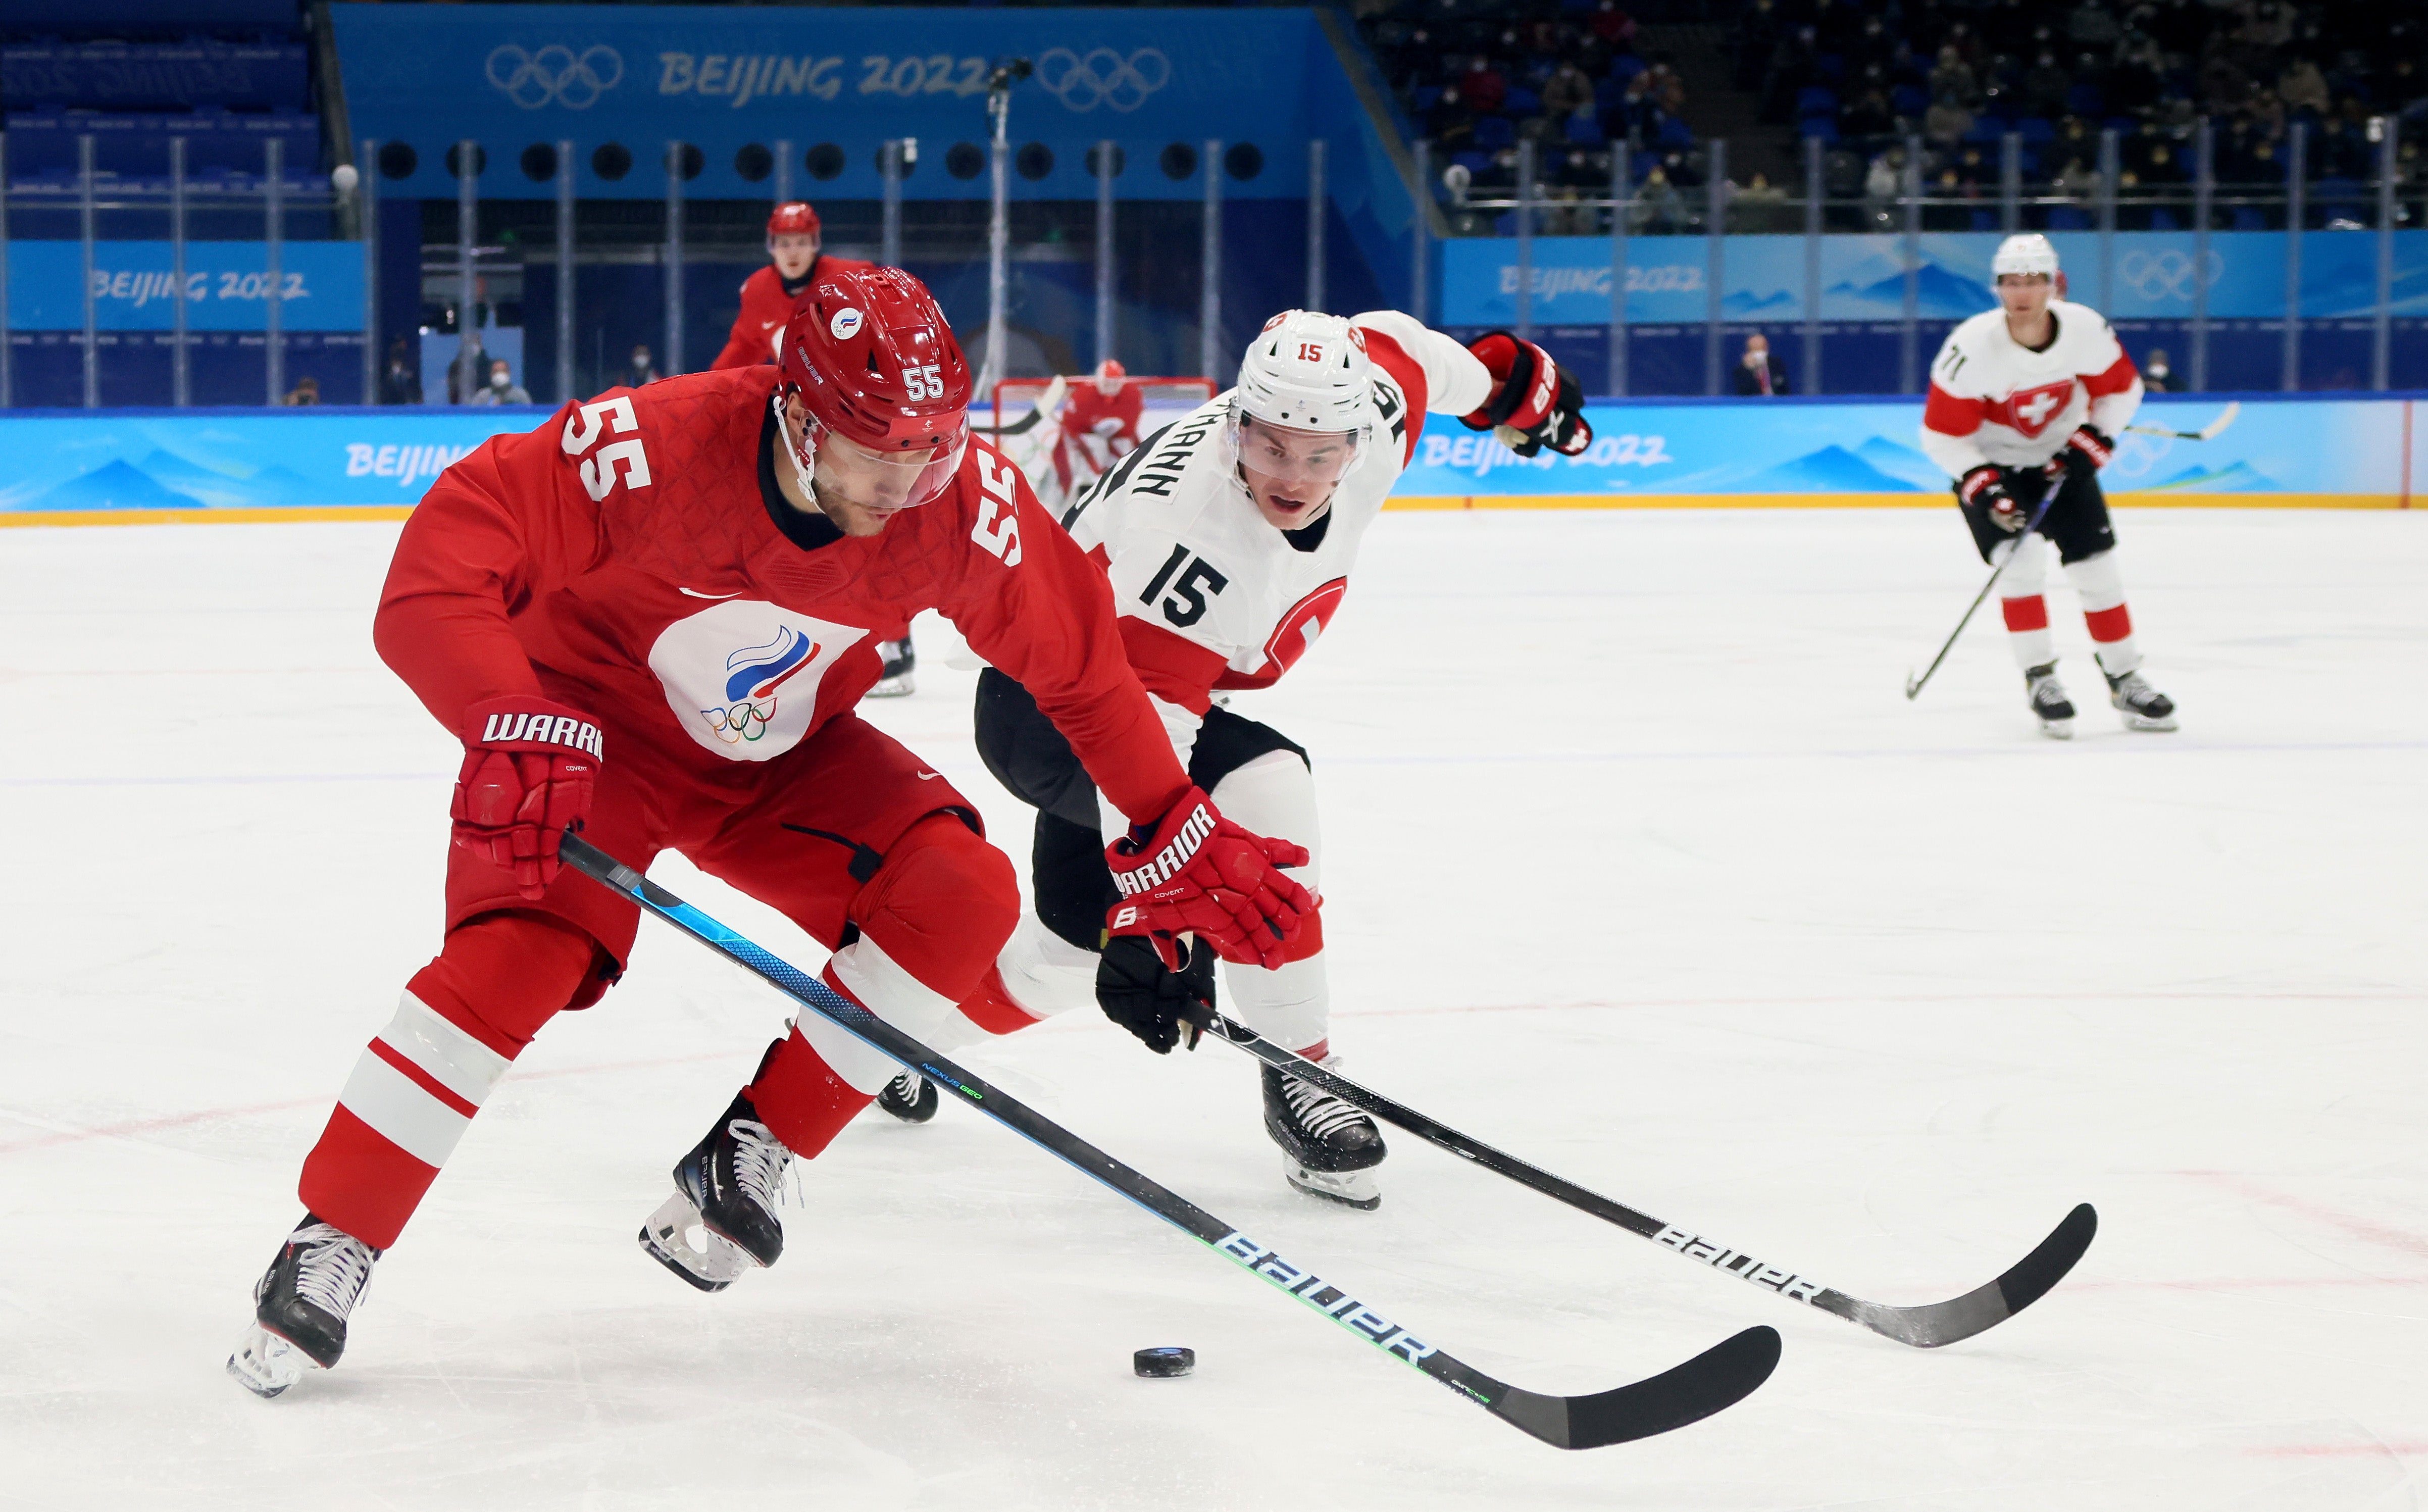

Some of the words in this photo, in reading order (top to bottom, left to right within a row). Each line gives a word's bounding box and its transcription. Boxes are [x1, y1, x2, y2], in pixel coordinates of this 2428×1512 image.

[659, 53, 844, 108] BEIJING
[860, 56, 991, 97] 2022
[91, 270, 208, 308] BEIJING
[1500, 266, 1612, 302] BEIJING
[1624, 266, 1704, 292] 2022
[1298, 343, 1323, 362] 15
[1942, 344, 1967, 382] 71
[902, 364, 944, 401] 55
[345, 442, 481, 487] BEIJIN
[561, 395, 652, 502] 55
[1131, 404, 1230, 496] MANN
[971, 448, 1022, 568] 55
[1139, 542, 1229, 628] 15
[566, 761, 587, 771] COVERT
[1154, 888, 1184, 898] COVERT
[922, 1062, 961, 1088] NEXUS
[959, 1085, 984, 1099] GEO
